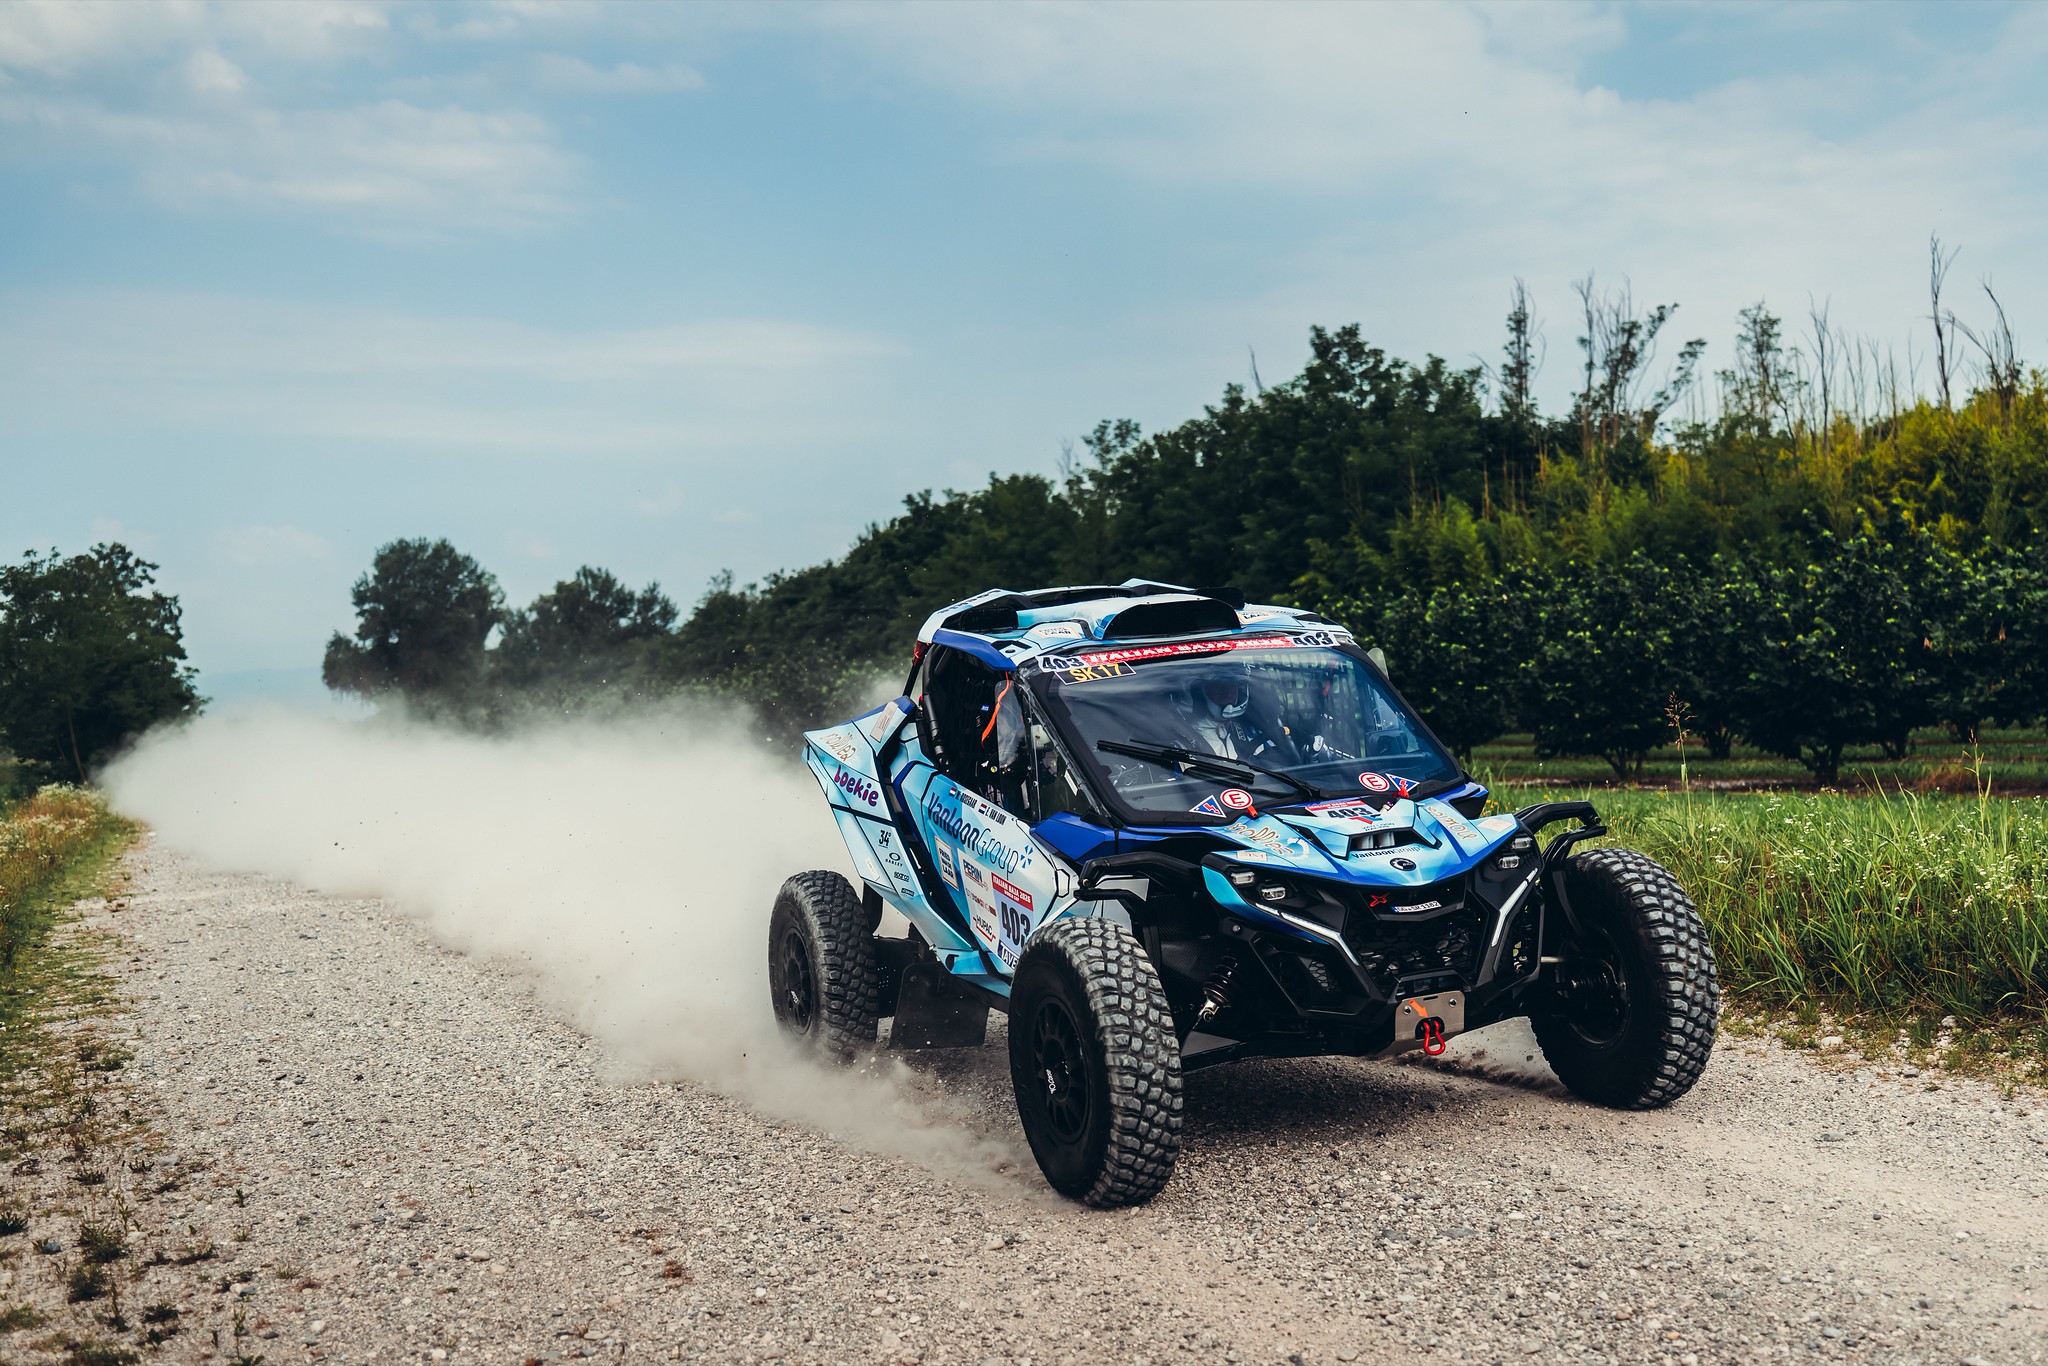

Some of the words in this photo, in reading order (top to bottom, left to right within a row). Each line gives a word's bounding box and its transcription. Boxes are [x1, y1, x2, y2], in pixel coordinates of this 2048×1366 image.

[1294, 632, 1333, 646] 403
[1089, 647, 1172, 662] ITALIAN
[1177, 642, 1231, 651] BAJA
[1042, 656, 1085, 670] 403
[1070, 666, 1103, 681] SK
[1097, 663, 1122, 678] 17
[1367, 776, 1380, 787] E
[1229, 793, 1242, 804] E
[1327, 806, 1371, 819] 403
[1001, 901, 1031, 949] 403
